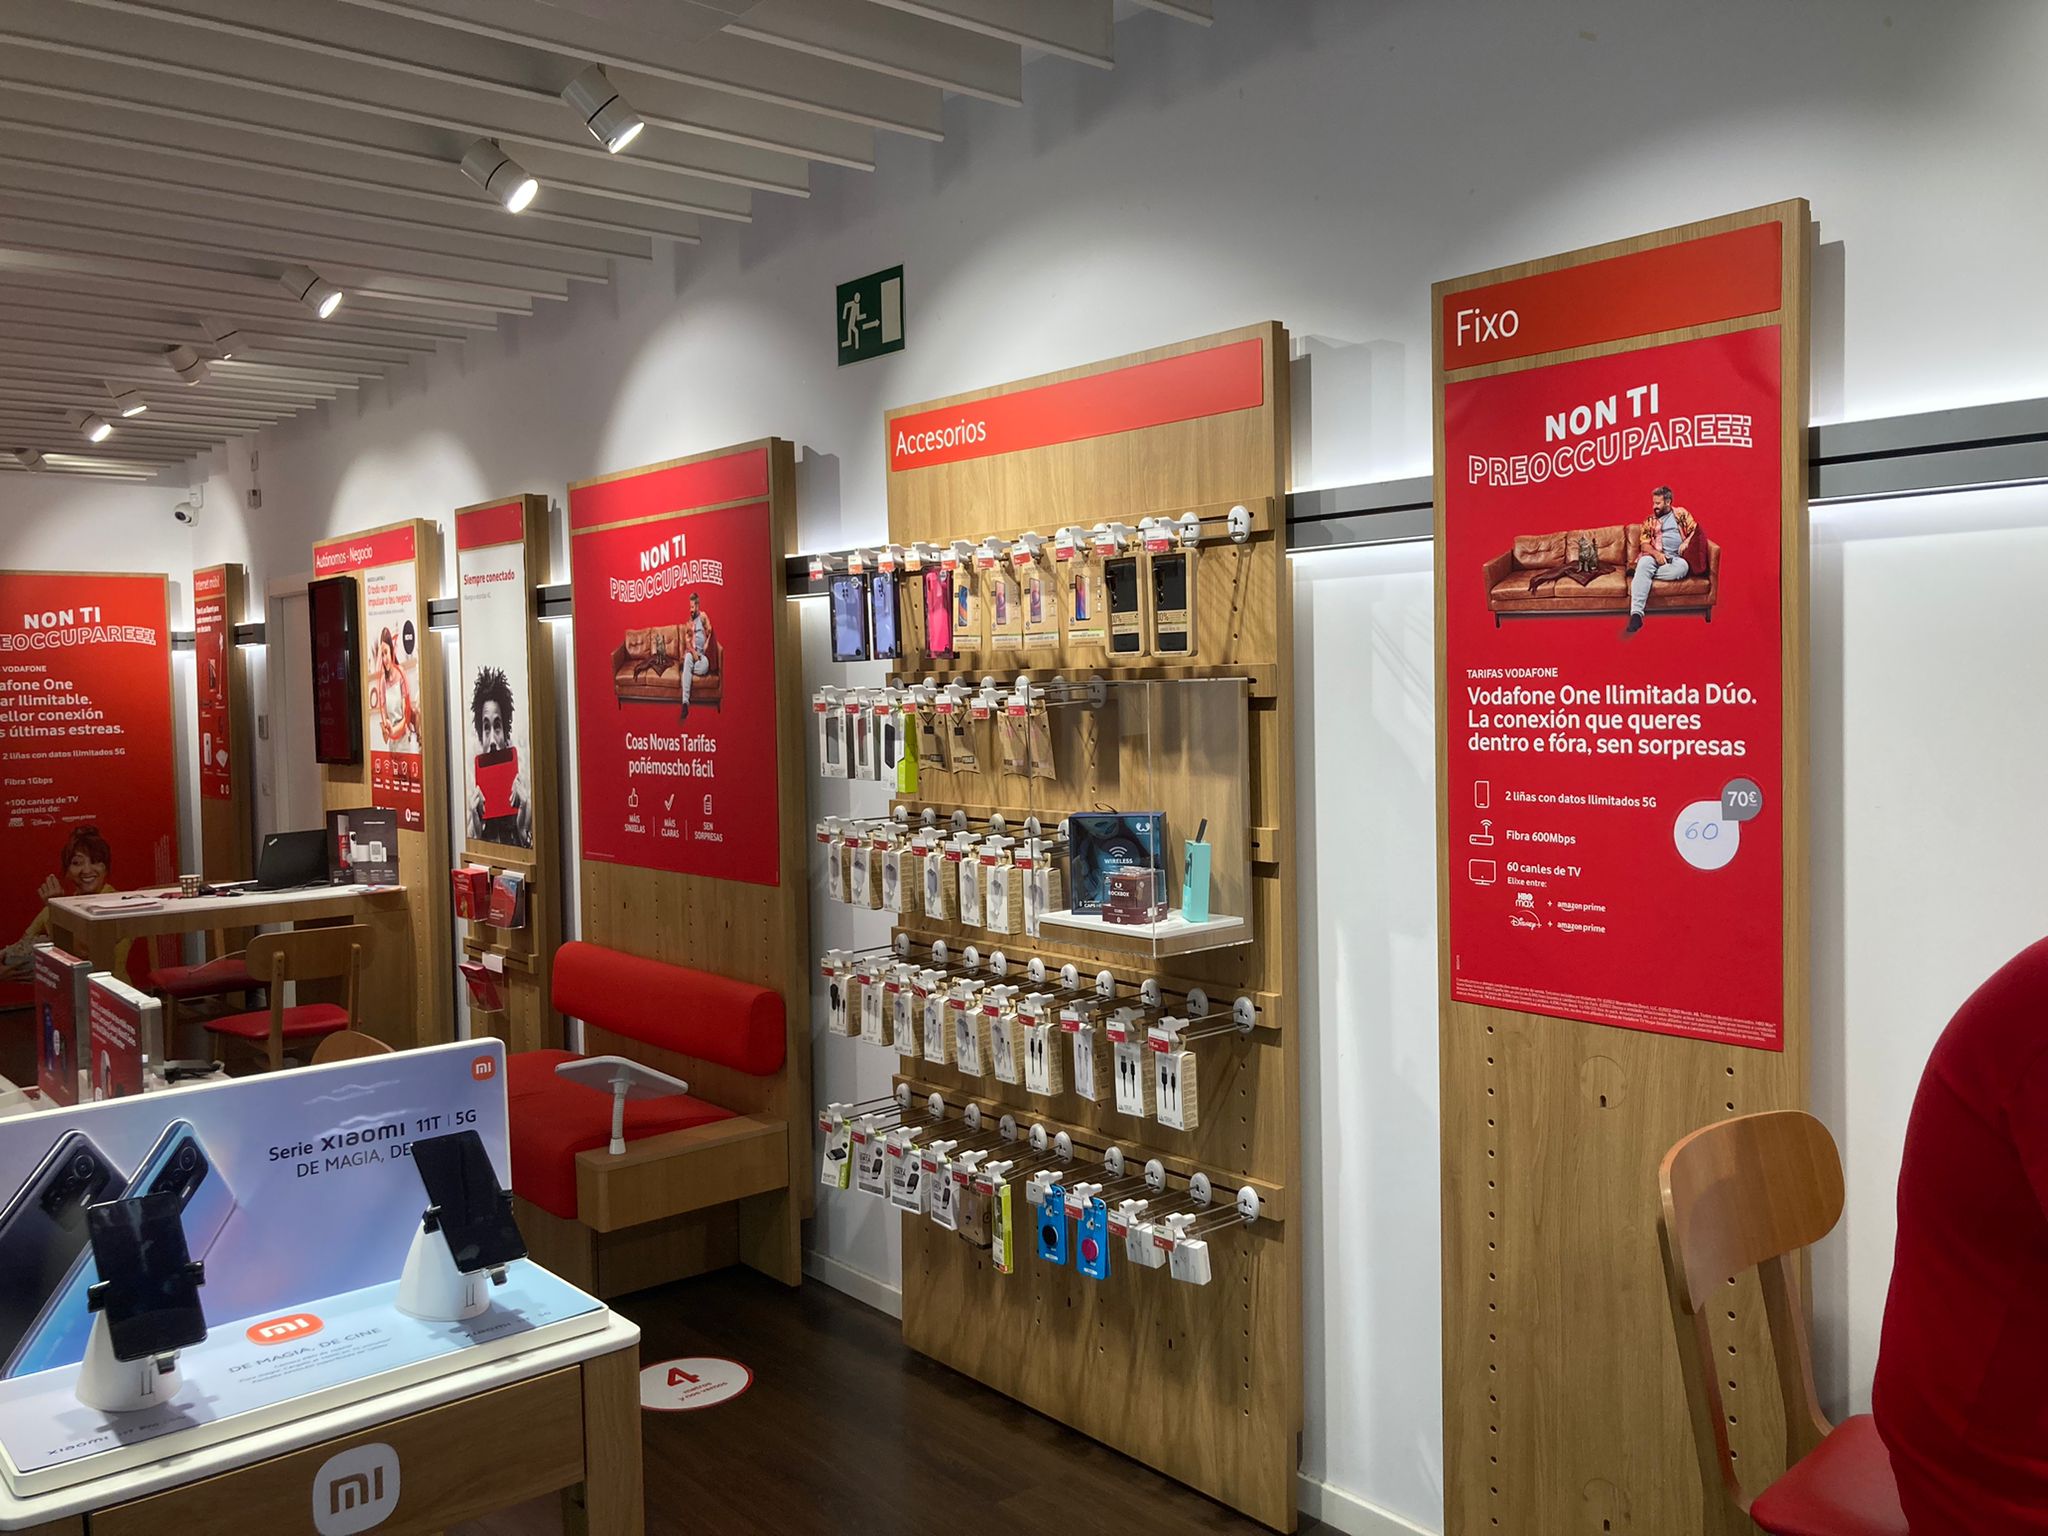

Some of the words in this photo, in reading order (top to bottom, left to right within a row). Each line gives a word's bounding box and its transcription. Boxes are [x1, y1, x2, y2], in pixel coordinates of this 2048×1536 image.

[1457, 308, 1519, 347] Fixo
[1545, 395, 1616, 442] NON
[1626, 383, 1659, 418] TI
[896, 418, 986, 456] Accesorios
[316, 552, 346, 568] Autónomos
[350, 544, 373, 564] Negocio
[640, 540, 670, 572] NON
[672, 533, 686, 558] TI
[464, 574, 485, 587] Siempre
[486, 569, 515, 583] conectado
[24, 609, 74, 629] NON
[80, 607, 101, 623] TI
[2, 665, 47, 673] VODAFONE
[1467, 668, 1503, 679] TARIFAS
[1505, 667, 1558, 678] VODAFONE
[43, 678, 73, 690] One
[19, 693, 92, 706] Ilimitable.
[1467, 686, 1556, 706] Vodafone
[1559, 685, 1600, 705] One
[1606, 684, 1699, 706] Ilimitada
[1705, 682, 1757, 705] Dúo.
[38, 708, 103, 721] conexión
[1468, 710, 1489, 729] La
[1494, 709, 1580, 730] conexión
[1585, 714, 1624, 734] que
[1628, 713, 1701, 734] queres
[9, 725, 65, 738] últimas
[69, 724, 125, 735] estreas.
[625, 732, 648, 750] Coas
[650, 733, 680, 751] Novas
[681, 734, 717, 753] Tarifas
[1468, 733, 1529, 752] dentro
[1533, 738, 1545, 752] e
[1549, 732, 1592, 756] fóra,
[1596, 738, 1633, 754] sen
[1637, 737, 1746, 760] sorpresas
[10, 752, 31, 760] liñas
[629, 757, 690, 777] poñémoscho
[692, 758, 714, 778] fácil
[28, 777, 53, 786] 1Gbps
[1505, 791, 1511, 801] 2
[1513, 791, 1537, 803] liñas
[1538, 794, 1557, 803] con
[1559, 793, 1586, 805] datos
[1588, 794, 1640, 807] Ilimitados
[1642, 796, 1657, 808] 5G
[1728, 791, 1757, 807] 70€
[1506, 830, 1531, 842] Fibra
[1532, 831, 1576, 847] 600Mbps
[1685, 821, 1719, 840] 60
[1507, 861, 1518, 872] 60
[1520, 863, 1552, 876] canles
[1554, 866, 1566, 877] de
[1567, 866, 1582, 877] TV
[1507, 877, 1526, 887] Elixe
[1526, 879, 1548, 888] entre:
[1517, 892, 1534, 901] HBO
[1515, 899, 1535, 909] max
[1557, 901, 1582, 912] amazon
[1583, 902, 1607, 913] prime
[1557, 921, 1582, 932] amazon
[1583, 922, 1606, 934] prime
[268, 1143, 313, 1162] Serie
[415, 1115, 441, 1133] 11T
[455, 1109, 477, 1126] 5G
[297, 1161, 320, 1178] DE
[325, 1149, 385, 1173] MAGIA,
[390, 1143, 411, 1160] DE
[229, 1362, 253, 1374] DE
[256, 1346, 316, 1366] MAGIA,
[319, 1338, 342, 1348] DE
[344, 1327, 383, 1341] CINE
